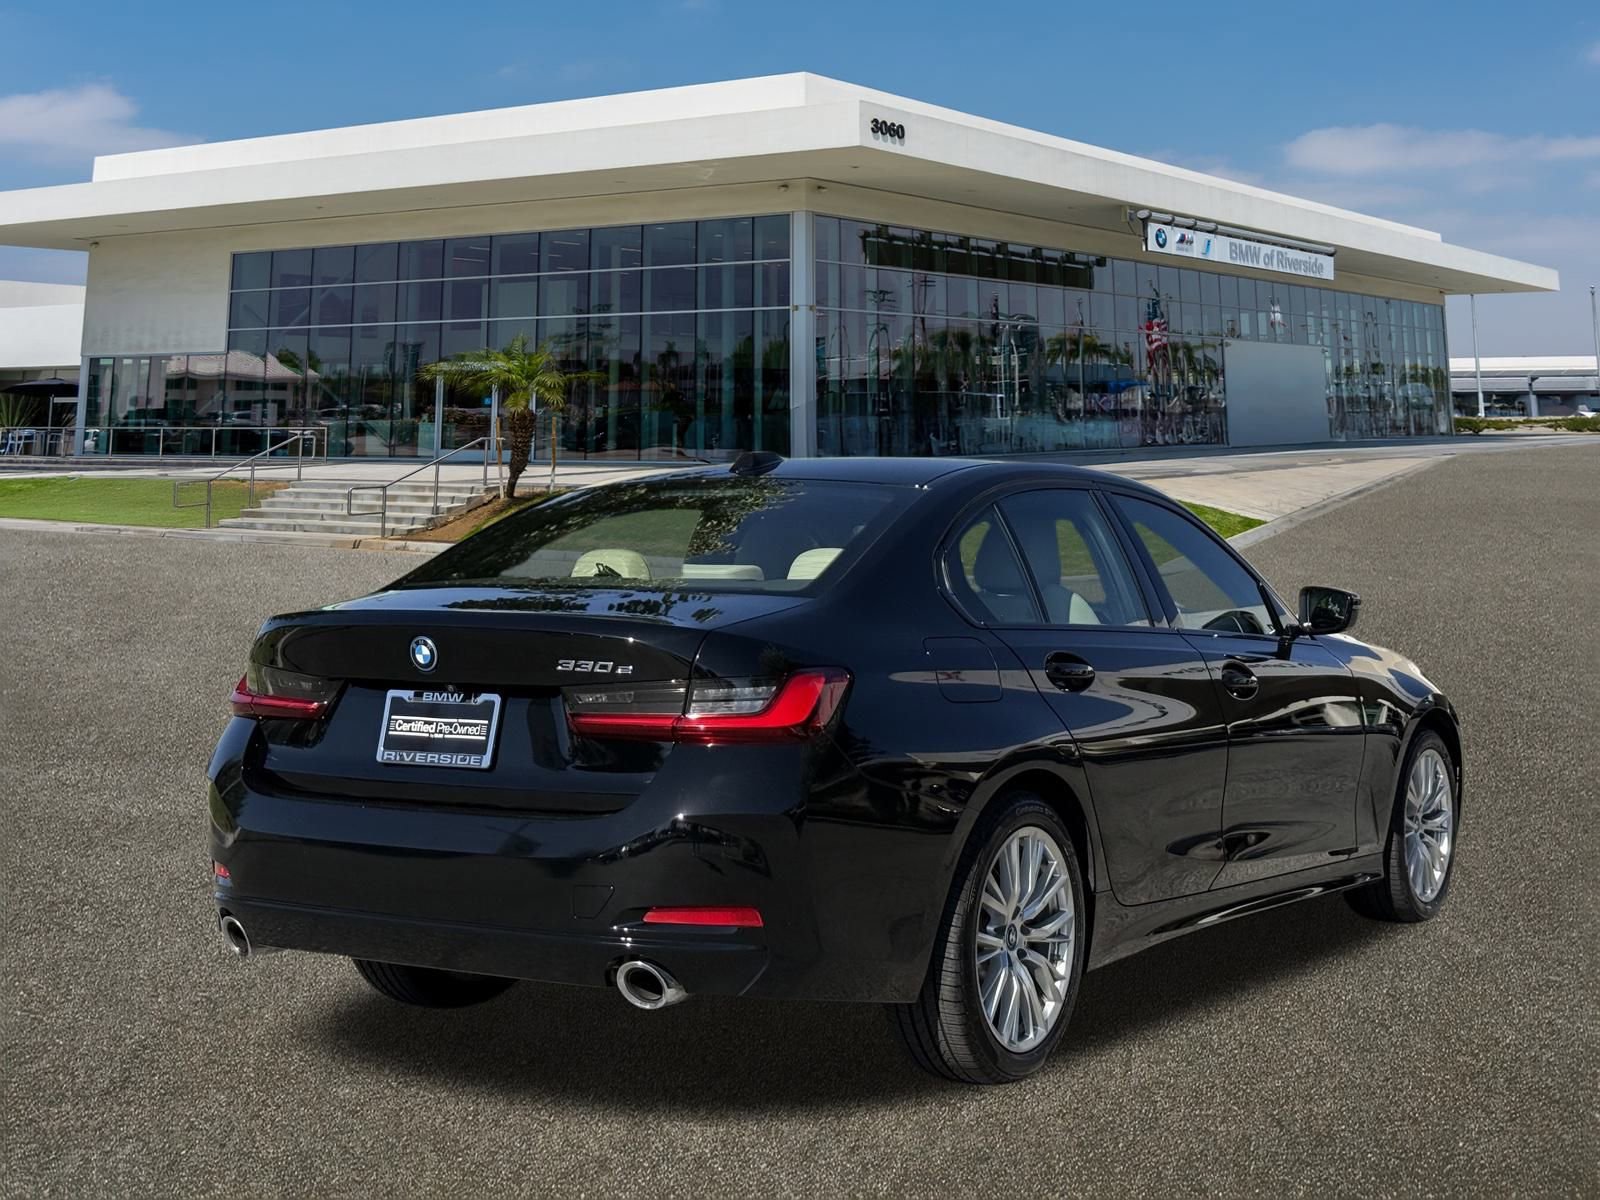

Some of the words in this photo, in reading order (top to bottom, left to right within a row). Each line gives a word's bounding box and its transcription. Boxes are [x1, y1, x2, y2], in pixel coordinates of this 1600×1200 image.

[870, 118, 905, 139] 3060
[1229, 241, 1261, 267] BMW
[1263, 251, 1274, 267] of
[1276, 251, 1325, 276] Riverside
[422, 692, 464, 703] BMW
[395, 719, 436, 733] Certified
[436, 722, 481, 736] Pre-Owned
[383, 751, 482, 766] RIVERSIDE
